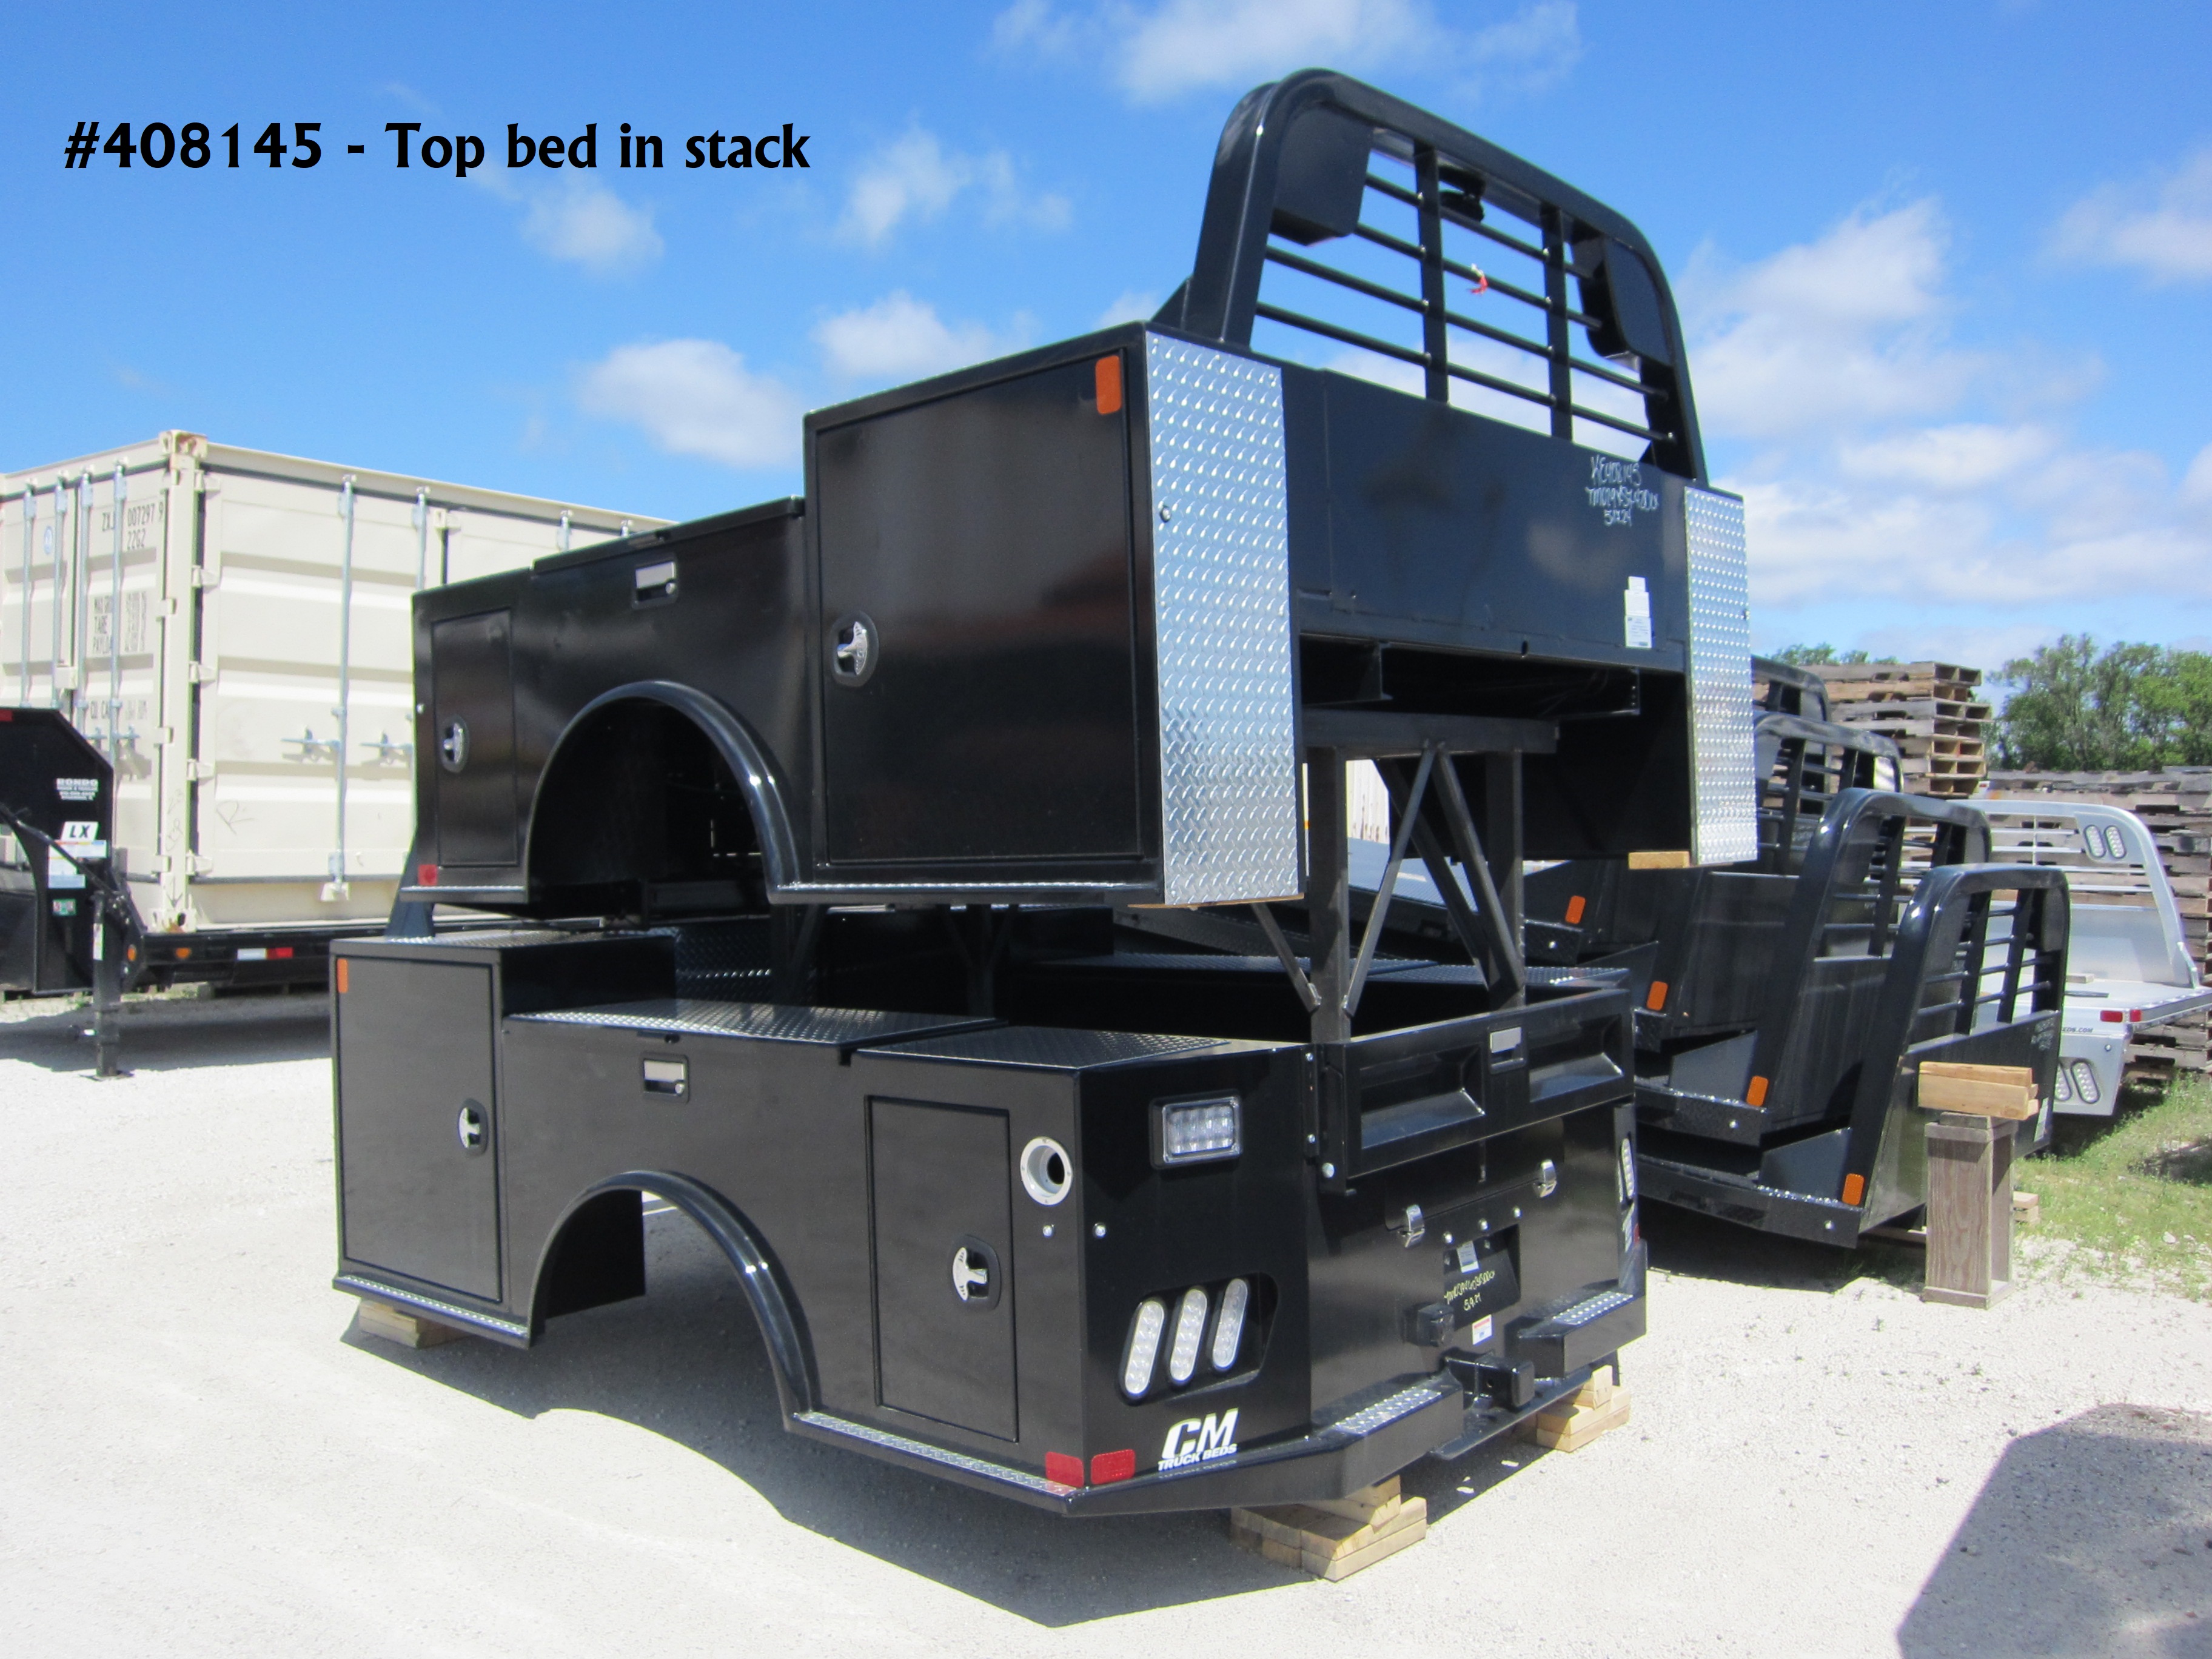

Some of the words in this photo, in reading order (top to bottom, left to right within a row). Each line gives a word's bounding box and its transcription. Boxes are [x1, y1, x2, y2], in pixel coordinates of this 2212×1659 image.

[128, 503, 155, 527] 007297
[70, 825, 91, 839] LX
[1161, 1407, 1239, 1458] CM
[1158, 1452, 1201, 1472] TRUCK
[1202, 1443, 1238, 1461] BEDS
